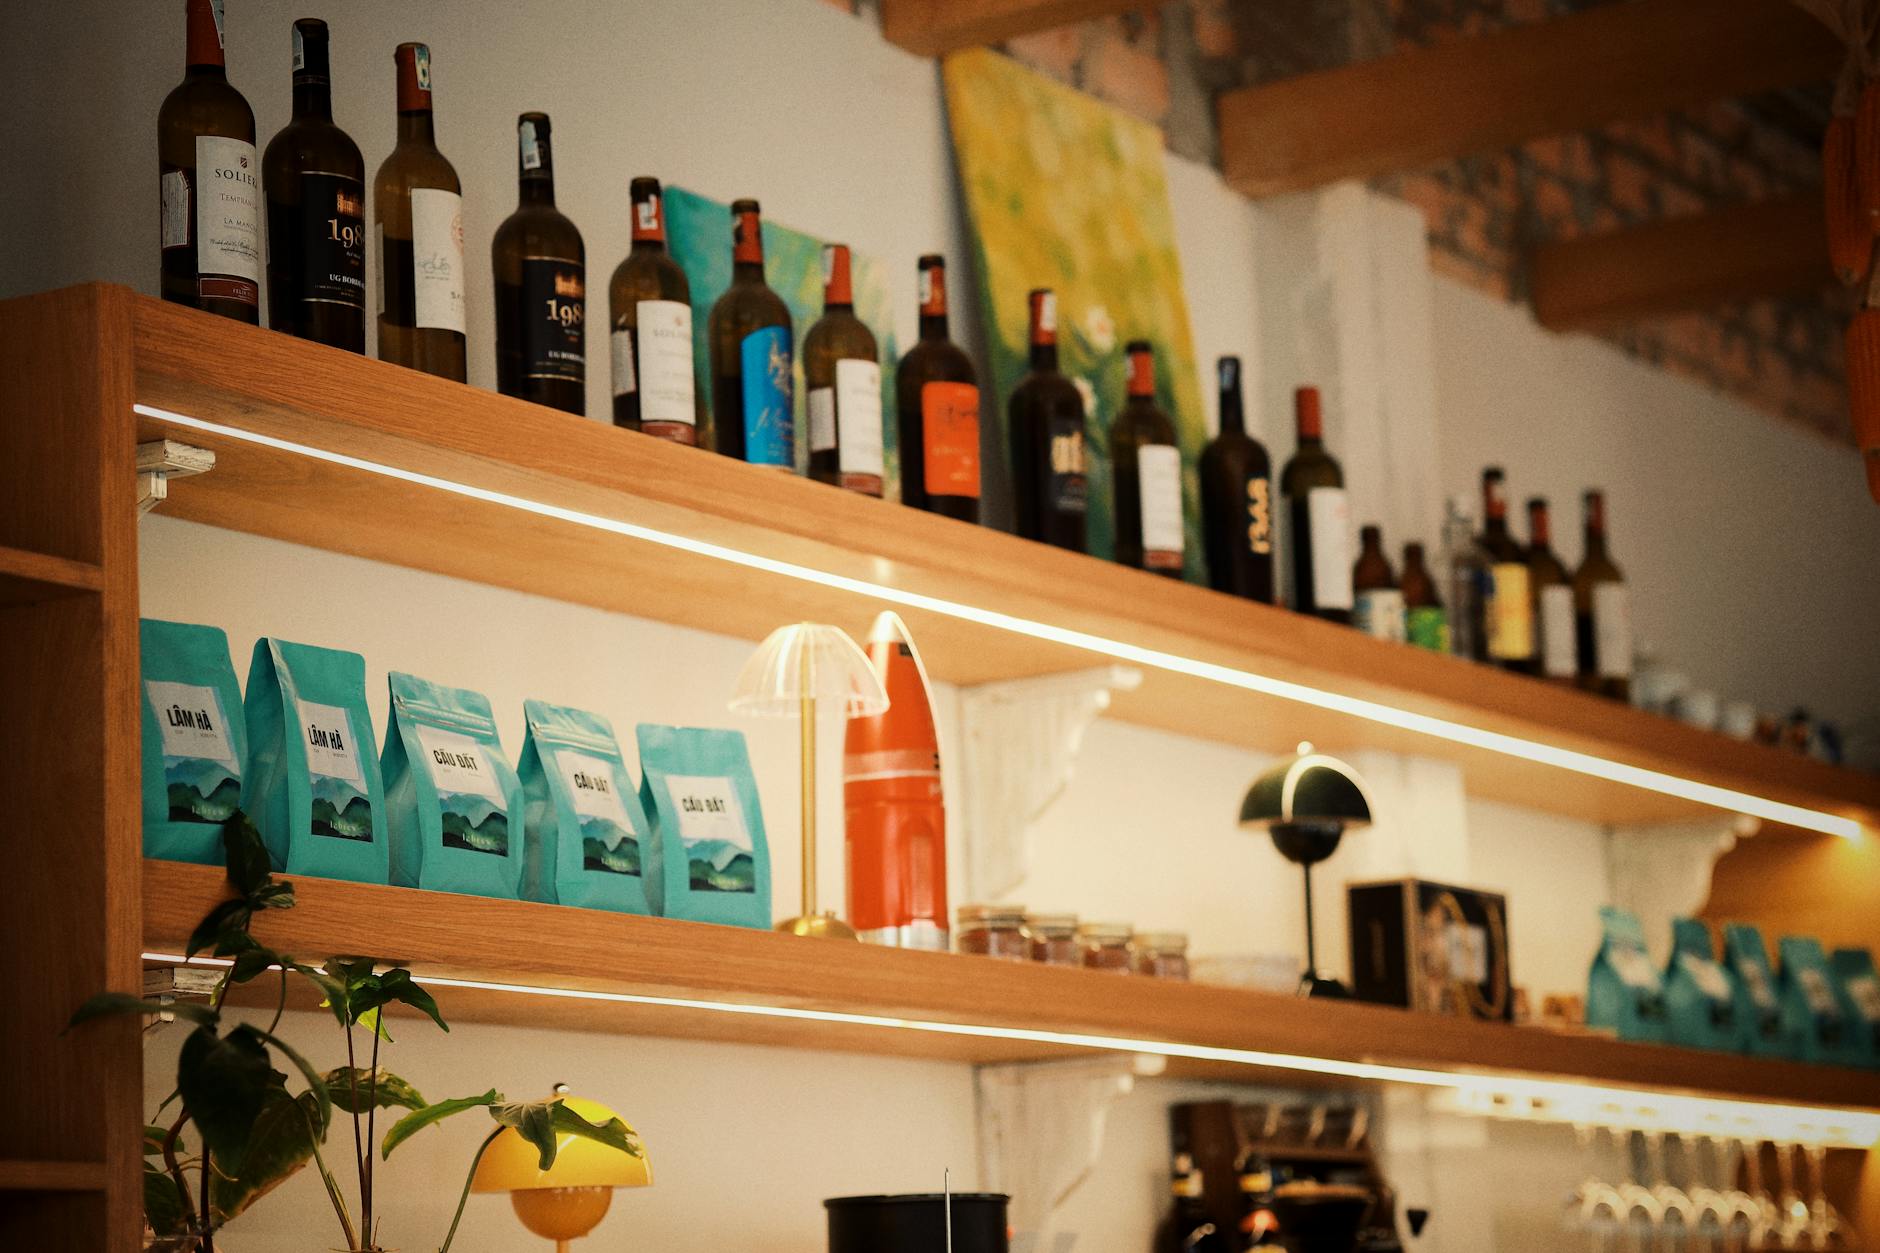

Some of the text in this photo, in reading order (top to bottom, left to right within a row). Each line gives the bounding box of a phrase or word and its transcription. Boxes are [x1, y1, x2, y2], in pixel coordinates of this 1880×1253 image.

[166, 704, 213, 731] LÂM HÀ
[307, 724, 344, 751] LÂM HÀ
